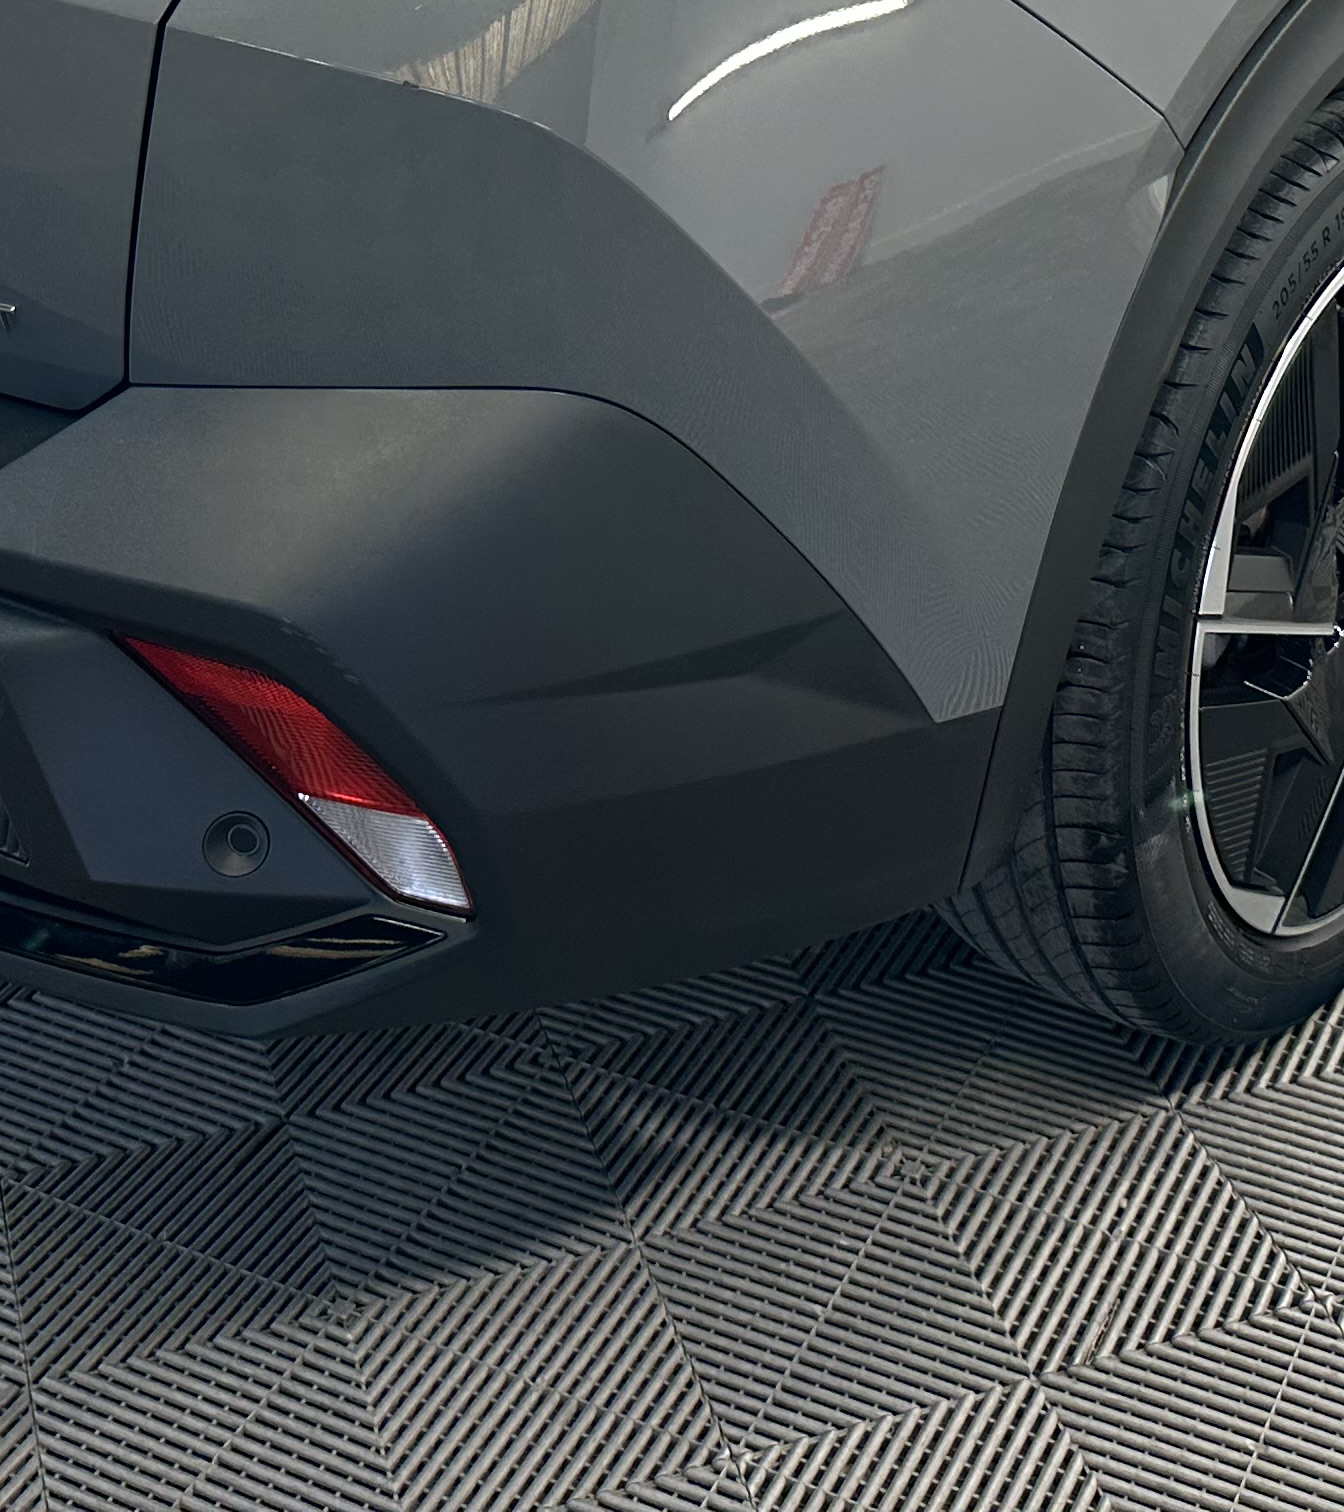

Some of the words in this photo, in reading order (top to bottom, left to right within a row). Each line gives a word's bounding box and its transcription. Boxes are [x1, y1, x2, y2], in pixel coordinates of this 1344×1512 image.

[1272, 241, 1319, 320] 205/55
[1321, 226, 1331, 248] R
[1154, 342, 1258, 677] MICHELIN
